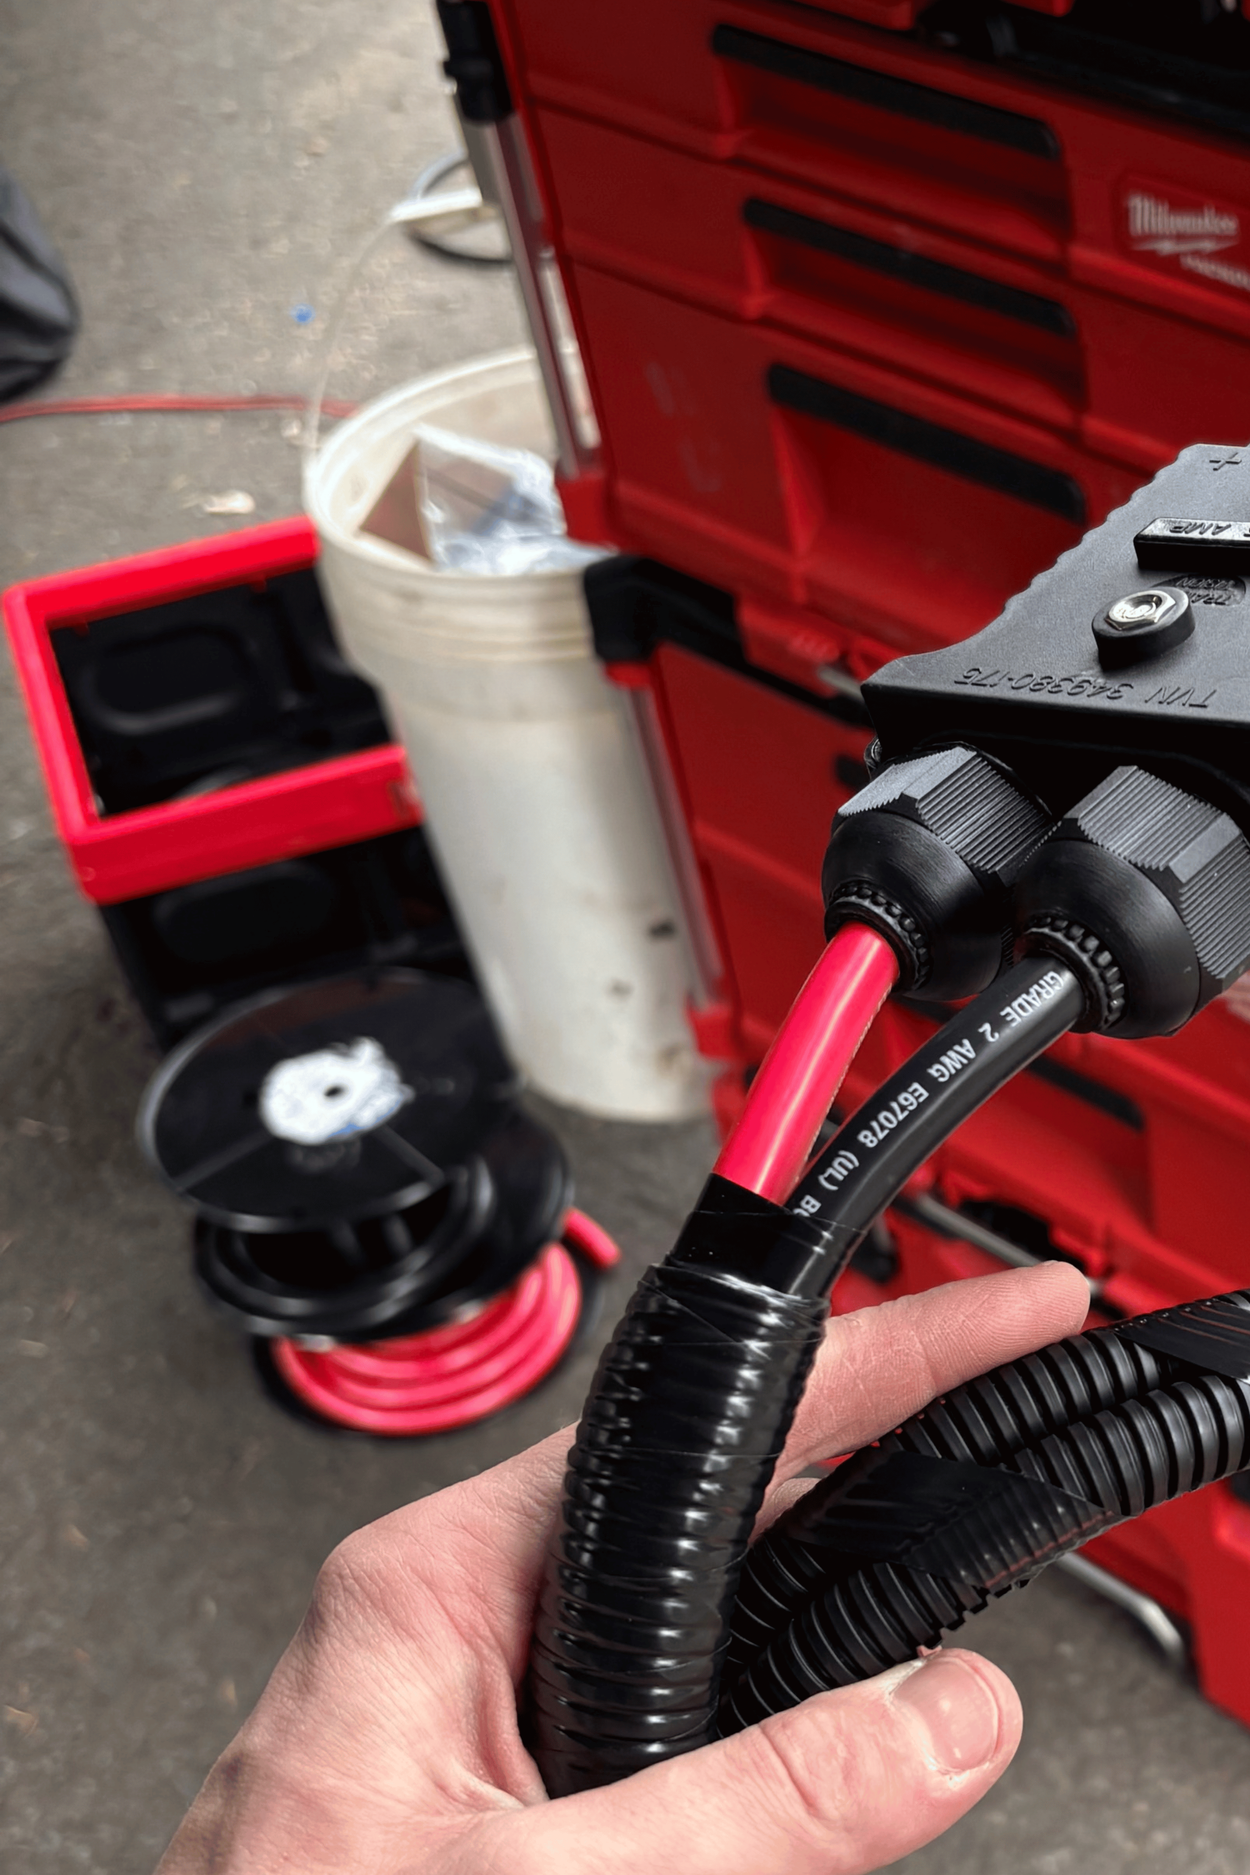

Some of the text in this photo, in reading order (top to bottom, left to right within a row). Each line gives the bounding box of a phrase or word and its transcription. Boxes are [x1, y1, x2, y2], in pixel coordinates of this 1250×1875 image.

[1169, 522, 1232, 537] AMP
[954, 667, 1217, 709] TVN 349380-175
[999, 970, 1064, 1028] GRADE
[977, 1022, 1000, 1042] 2
[926, 1038, 977, 1083] AWG
[856, 1081, 930, 1149] E67078
[817, 1149, 860, 1191] (UL)
